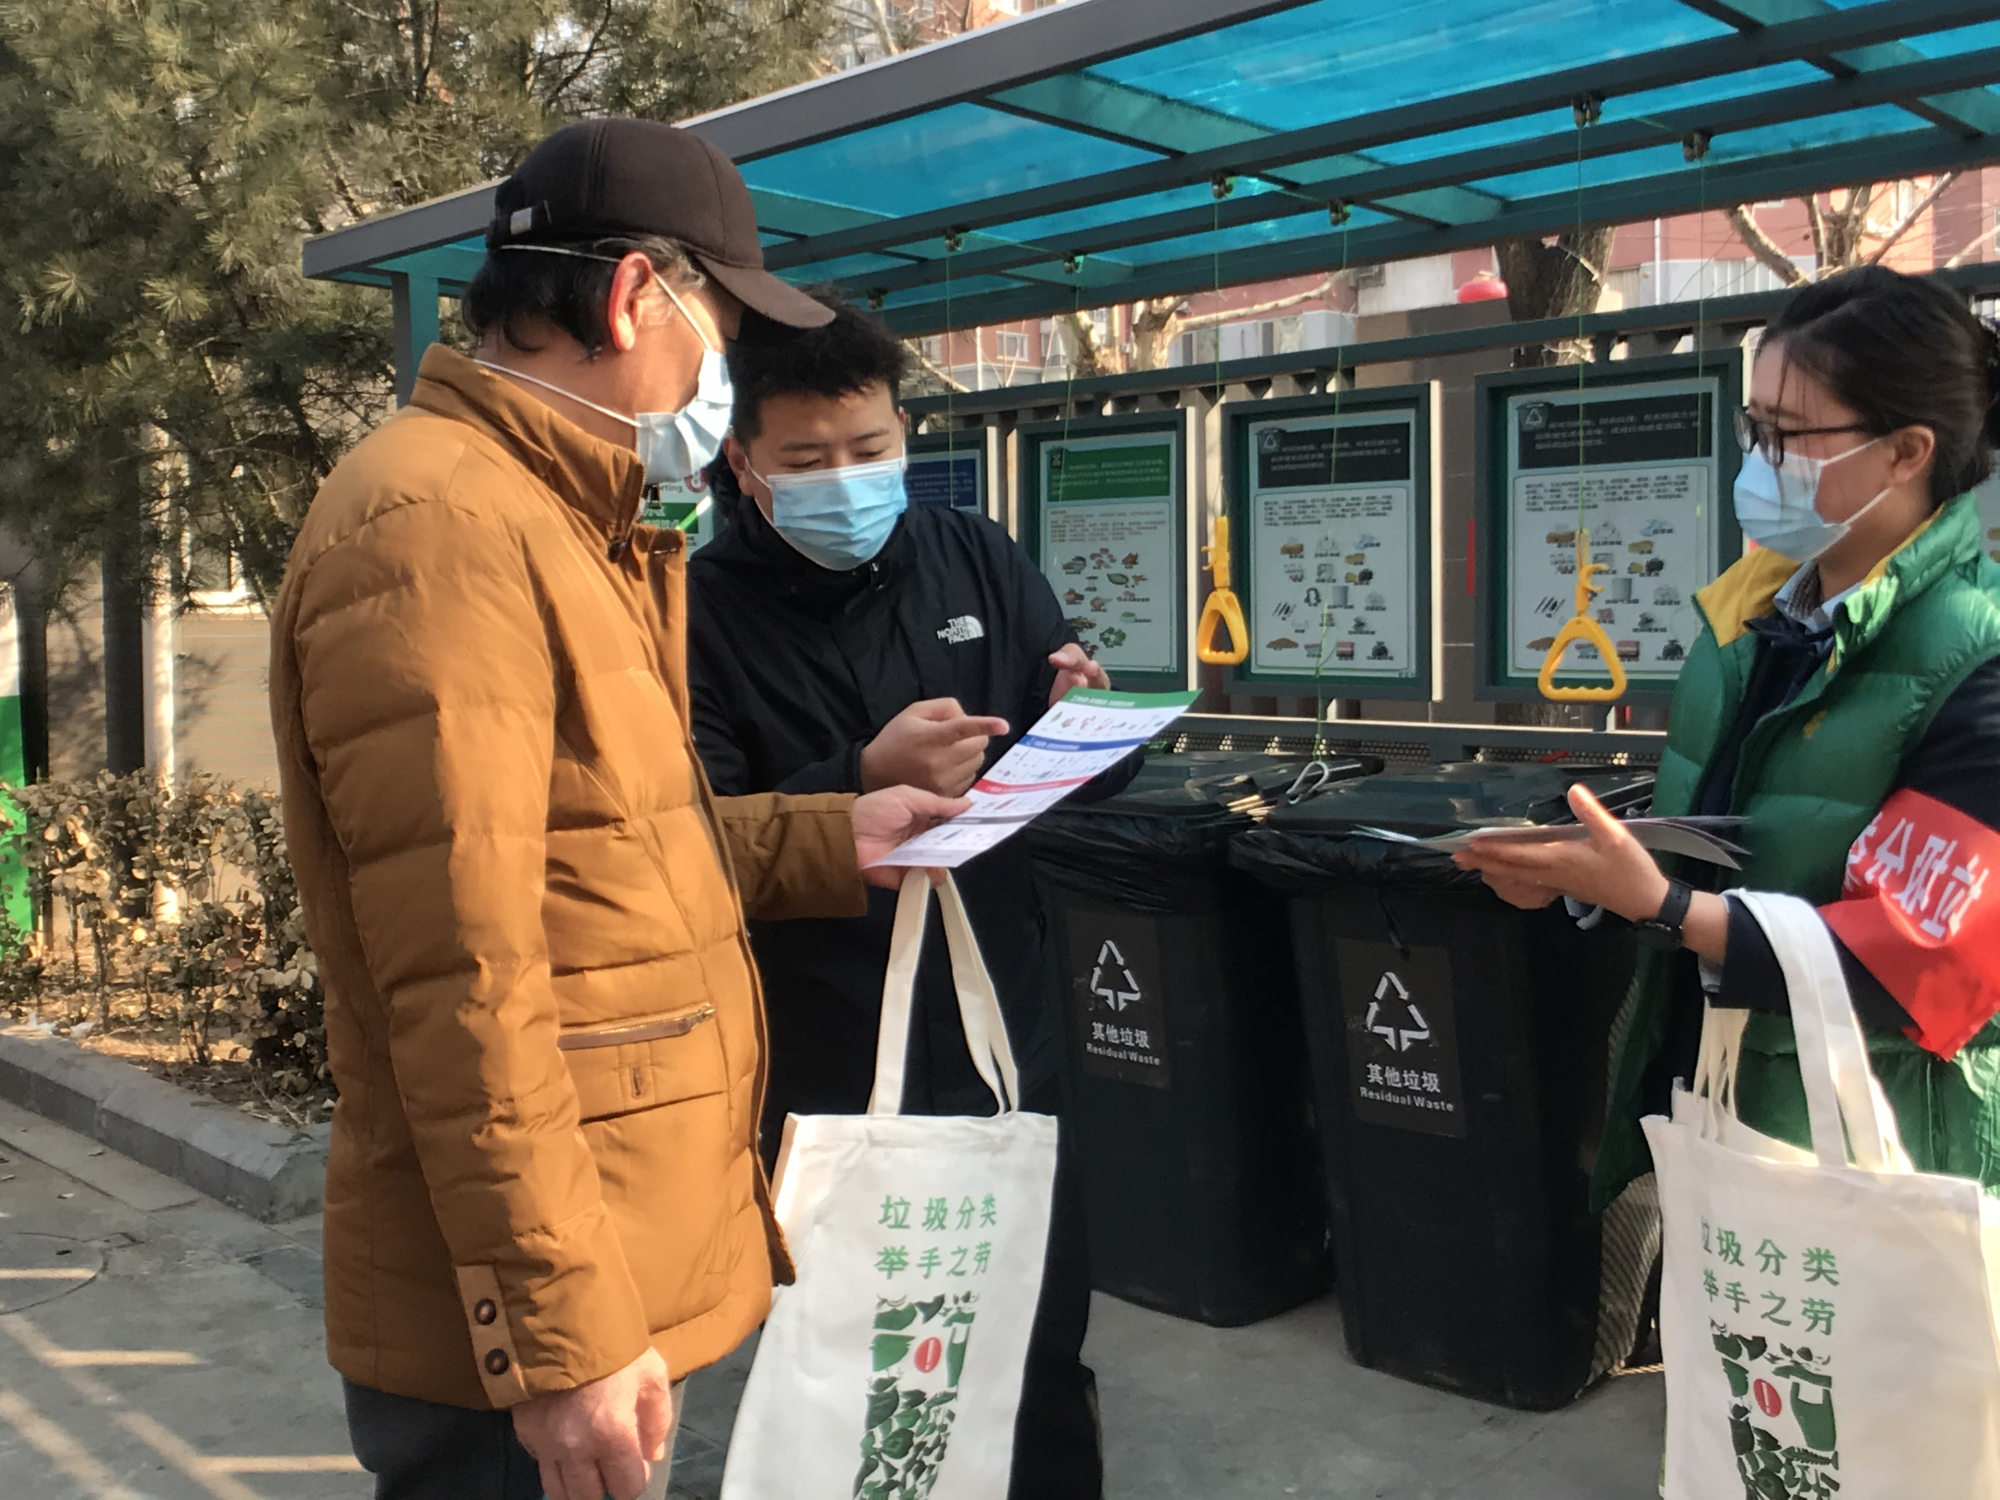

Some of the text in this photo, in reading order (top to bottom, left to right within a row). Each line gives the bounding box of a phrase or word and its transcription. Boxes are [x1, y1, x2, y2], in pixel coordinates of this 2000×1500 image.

[937, 625, 970, 640] NORTH
[946, 616, 967, 629] THE
[948, 632, 971, 645] FACE
[1091, 1021, 1150, 1050] 其他垃圾
[1086, 1042, 1160, 1066] Residual Waste
[1366, 1063, 1441, 1093] 其他垃圾
[1360, 1086, 1454, 1112] Residual Waste
[878, 1193, 997, 1232] 垃圾分类
[873, 1240, 993, 1280] 举手之劳
[1703, 1267, 1836, 1336] 举手之劳
